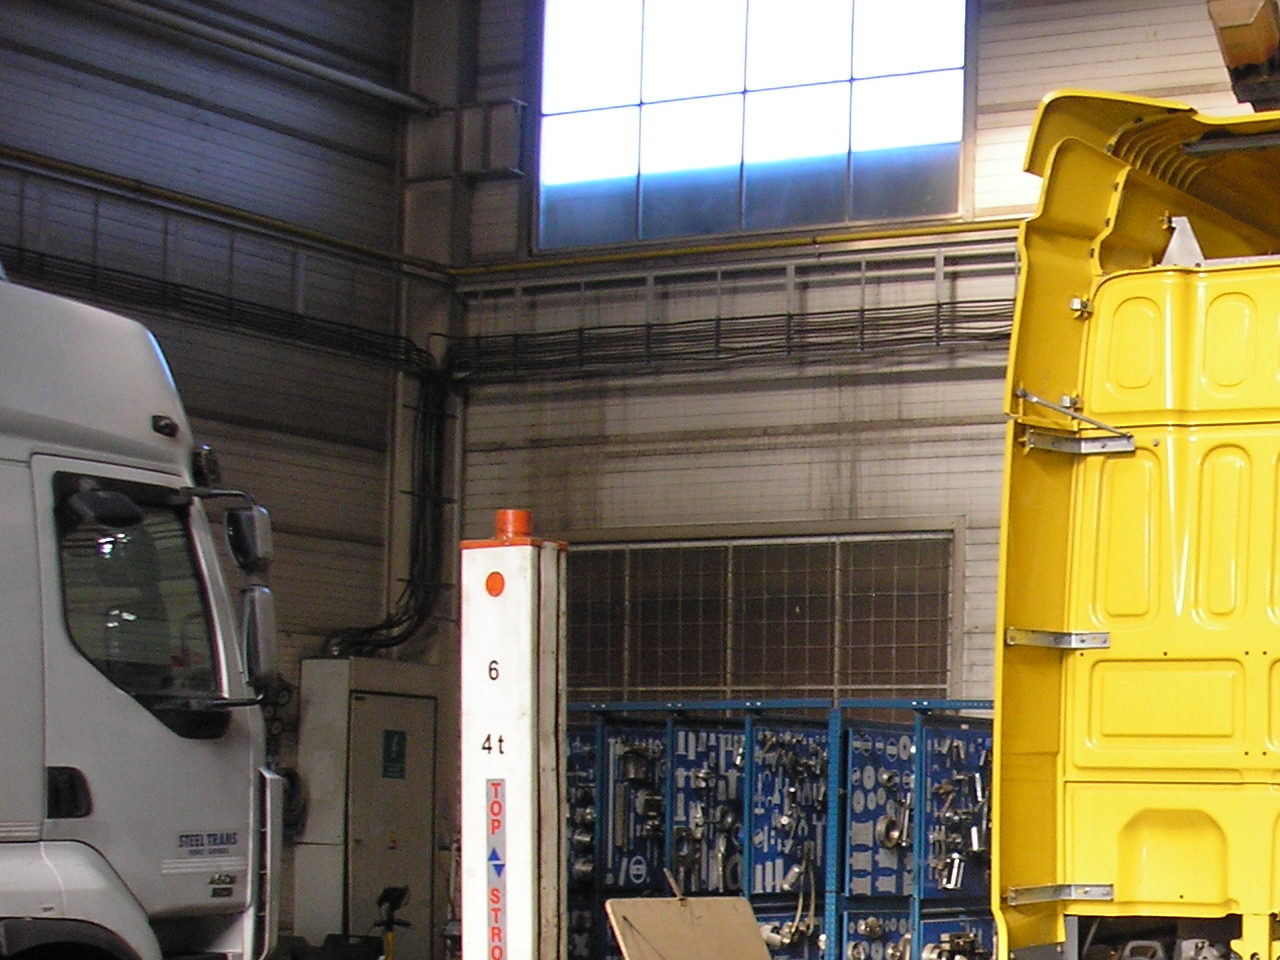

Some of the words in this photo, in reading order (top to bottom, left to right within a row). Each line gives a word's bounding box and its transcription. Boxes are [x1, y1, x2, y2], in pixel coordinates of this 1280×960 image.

[488, 660, 499, 681] 6
[481, 733, 493, 754] 4
[498, 735, 505, 754] t
[490, 783, 502, 834] TOP
